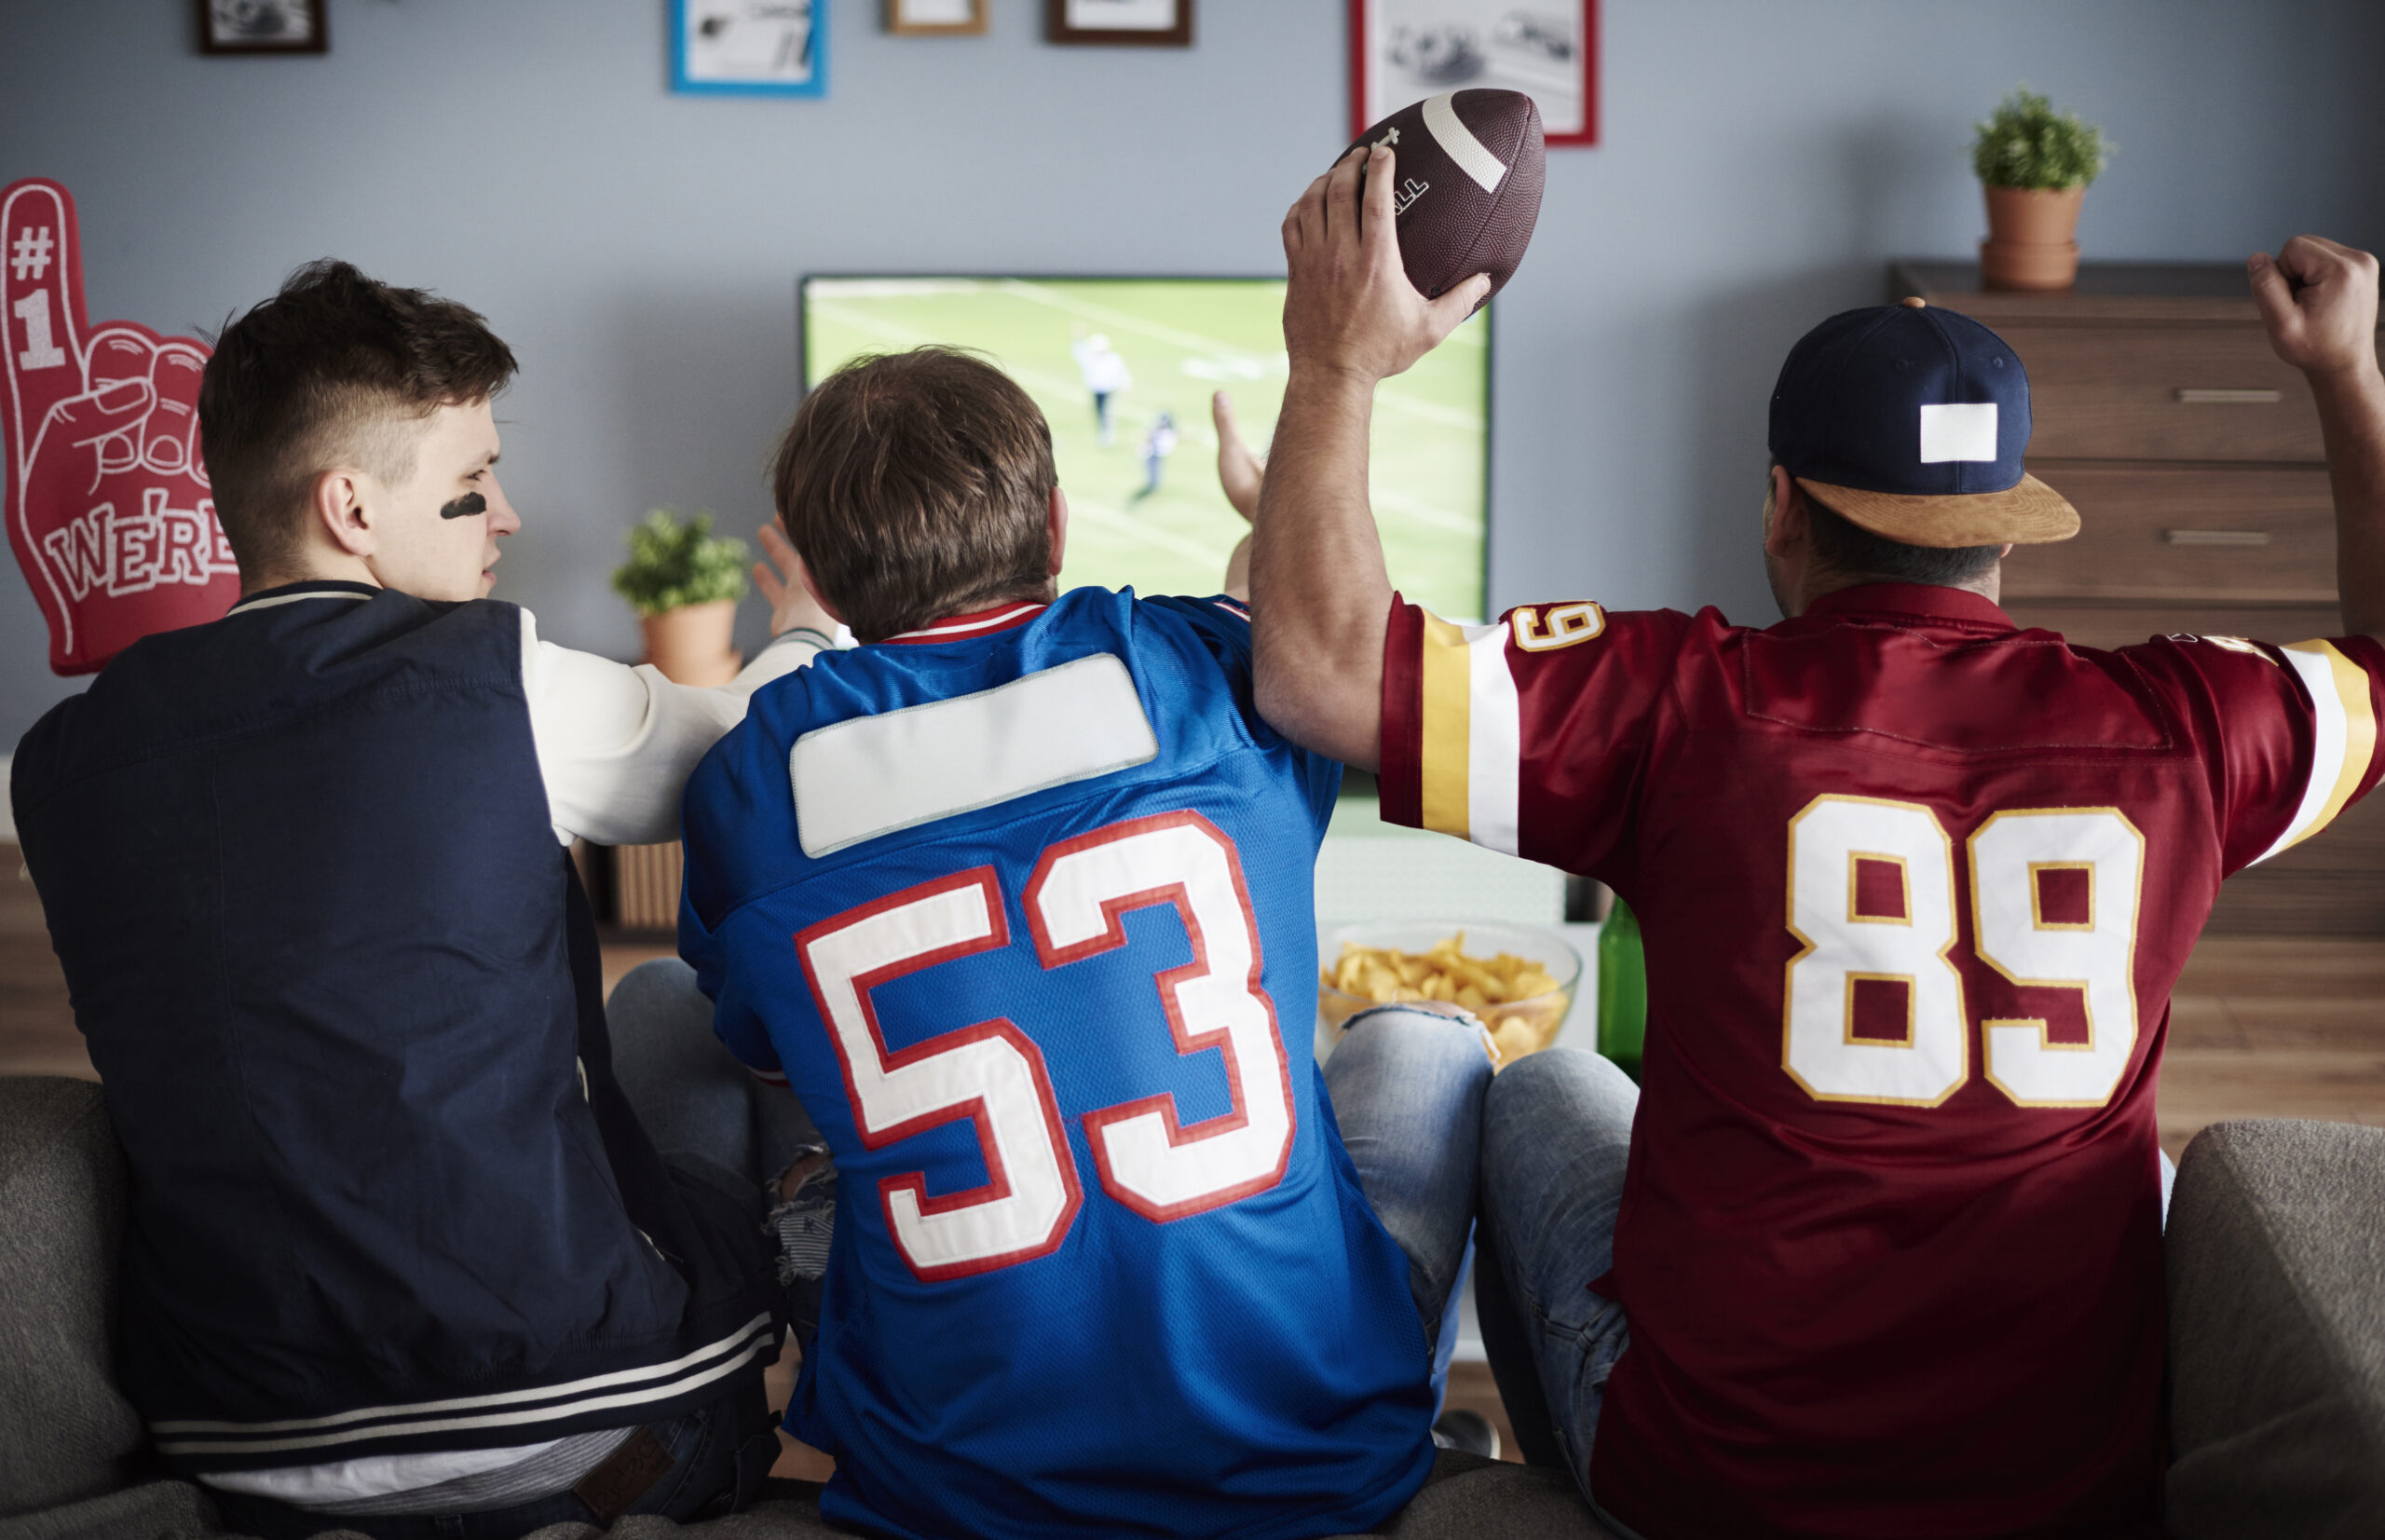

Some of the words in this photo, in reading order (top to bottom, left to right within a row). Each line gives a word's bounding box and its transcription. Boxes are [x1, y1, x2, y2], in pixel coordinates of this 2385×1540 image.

[1394, 178, 1429, 215] LL
[794, 809, 1297, 1283] 53
[1780, 793, 2146, 1108] 89
